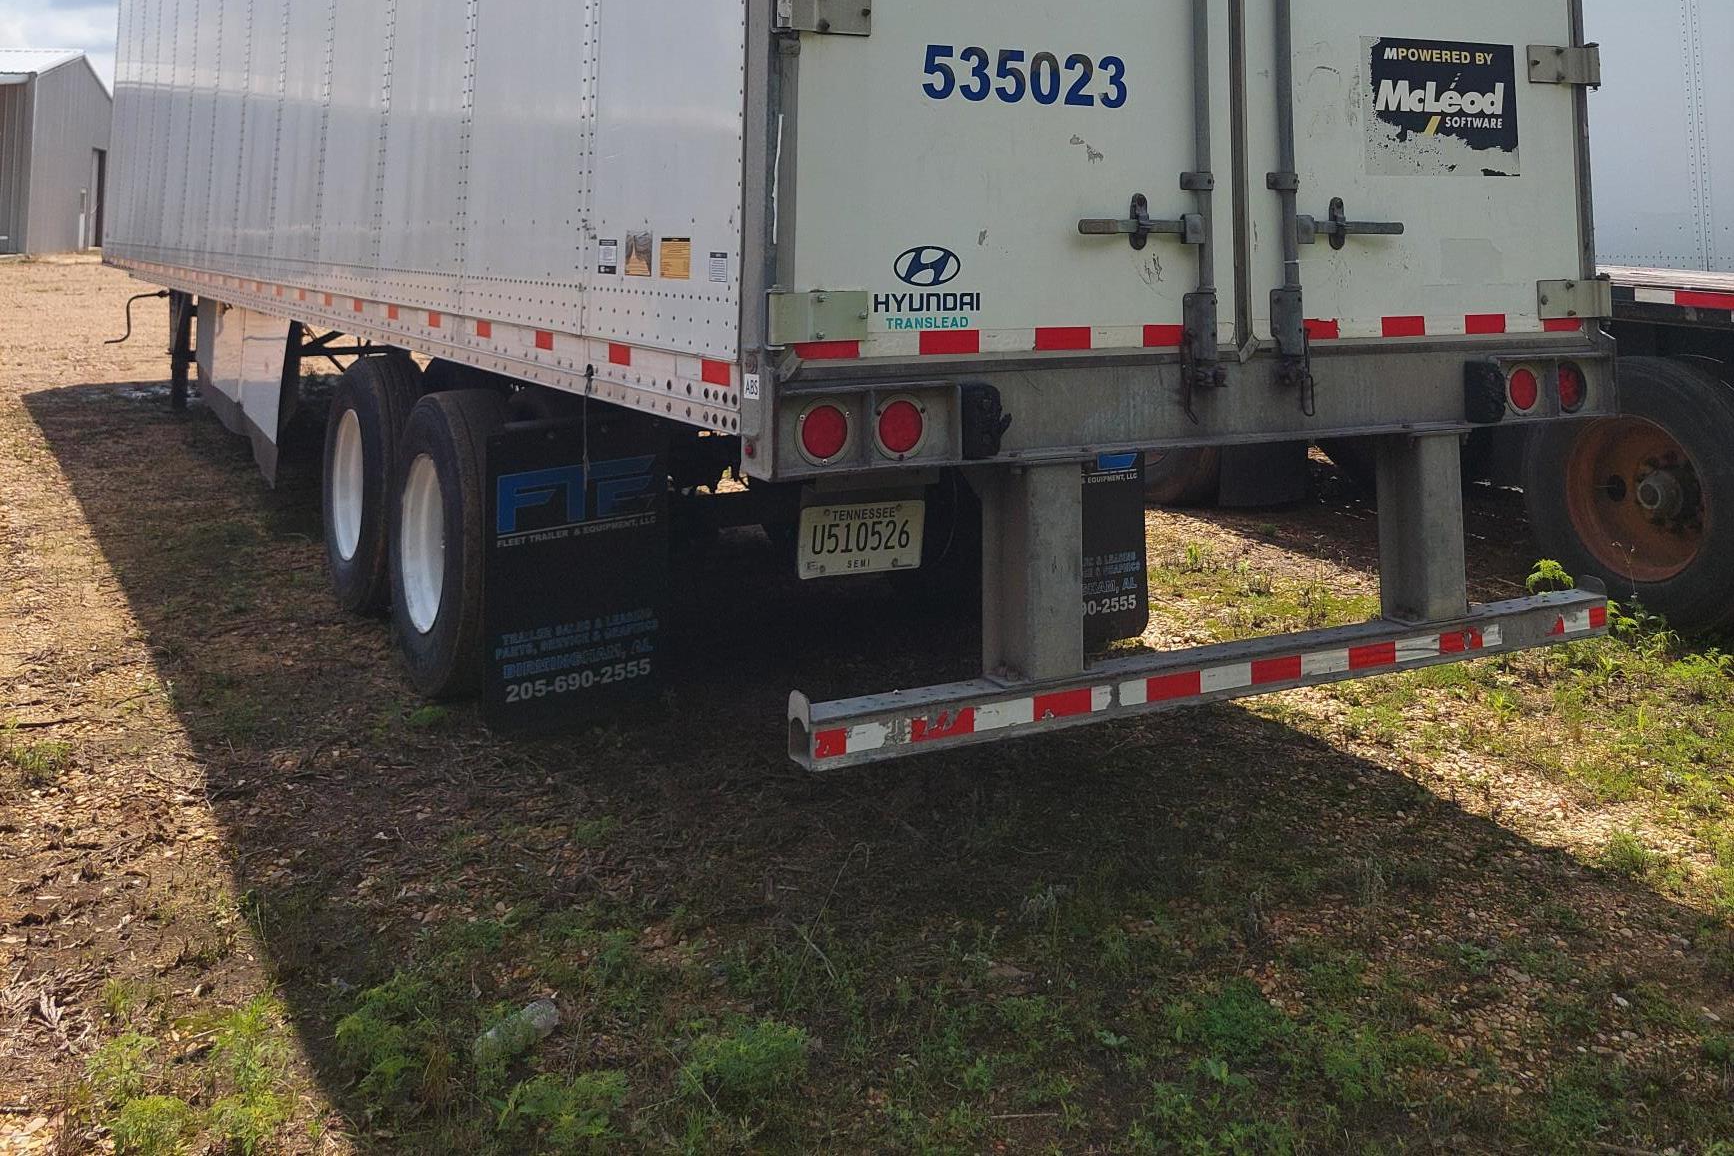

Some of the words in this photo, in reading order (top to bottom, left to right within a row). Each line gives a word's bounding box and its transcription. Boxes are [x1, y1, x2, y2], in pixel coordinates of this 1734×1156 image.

[1384, 47, 1471, 64] MPOWERED
[1475, 52, 1493, 65] BY
[922, 44, 1128, 109] 535023
[1375, 79, 1504, 115] McLeod
[1445, 116, 1503, 129] SOFTWARE
[874, 292, 980, 314] HYUNDAI
[886, 316, 968, 330] TRANSLEAD
[745, 380, 759, 396] ABS
[1126, 472, 1138, 480] LLC
[832, 507, 896, 521] TENNESSEE
[497, 536, 526, 548] FLEET
[529, 529, 569, 543] TRAILER
[640, 515, 656, 525] LLC
[812, 519, 910, 555] U510526
[847, 559, 870, 569] SEMI
[1122, 577, 1138, 590] AL
[505, 658, 651, 703] 205-690-2555
